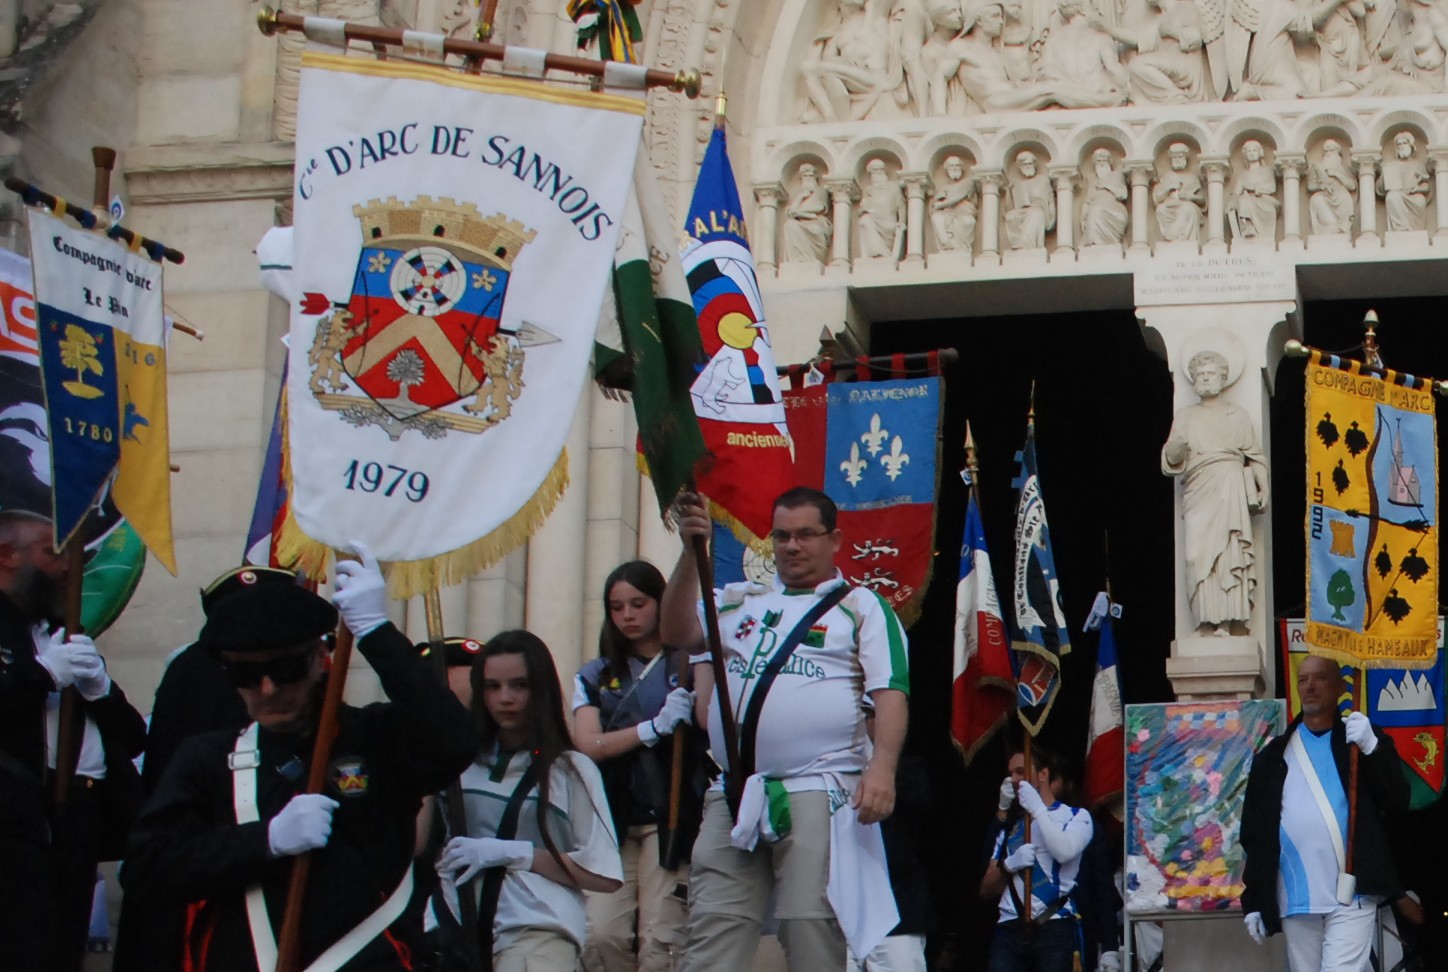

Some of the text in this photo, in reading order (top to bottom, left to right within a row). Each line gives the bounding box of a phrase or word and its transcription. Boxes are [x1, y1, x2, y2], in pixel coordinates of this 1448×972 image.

[325, 122, 419, 177] D'ARC
[430, 124, 474, 158] DE
[482, 134, 614, 242] SANNOIS
[53, 235, 152, 291] Compagnie d'arc
[83, 286, 129, 319] Le Pin
[64, 416, 113, 443] 1780
[343, 458, 430, 503] 1979
[1311, 471, 1324, 541] 1992
[1366, 634, 1428, 657] HAMEAUX
